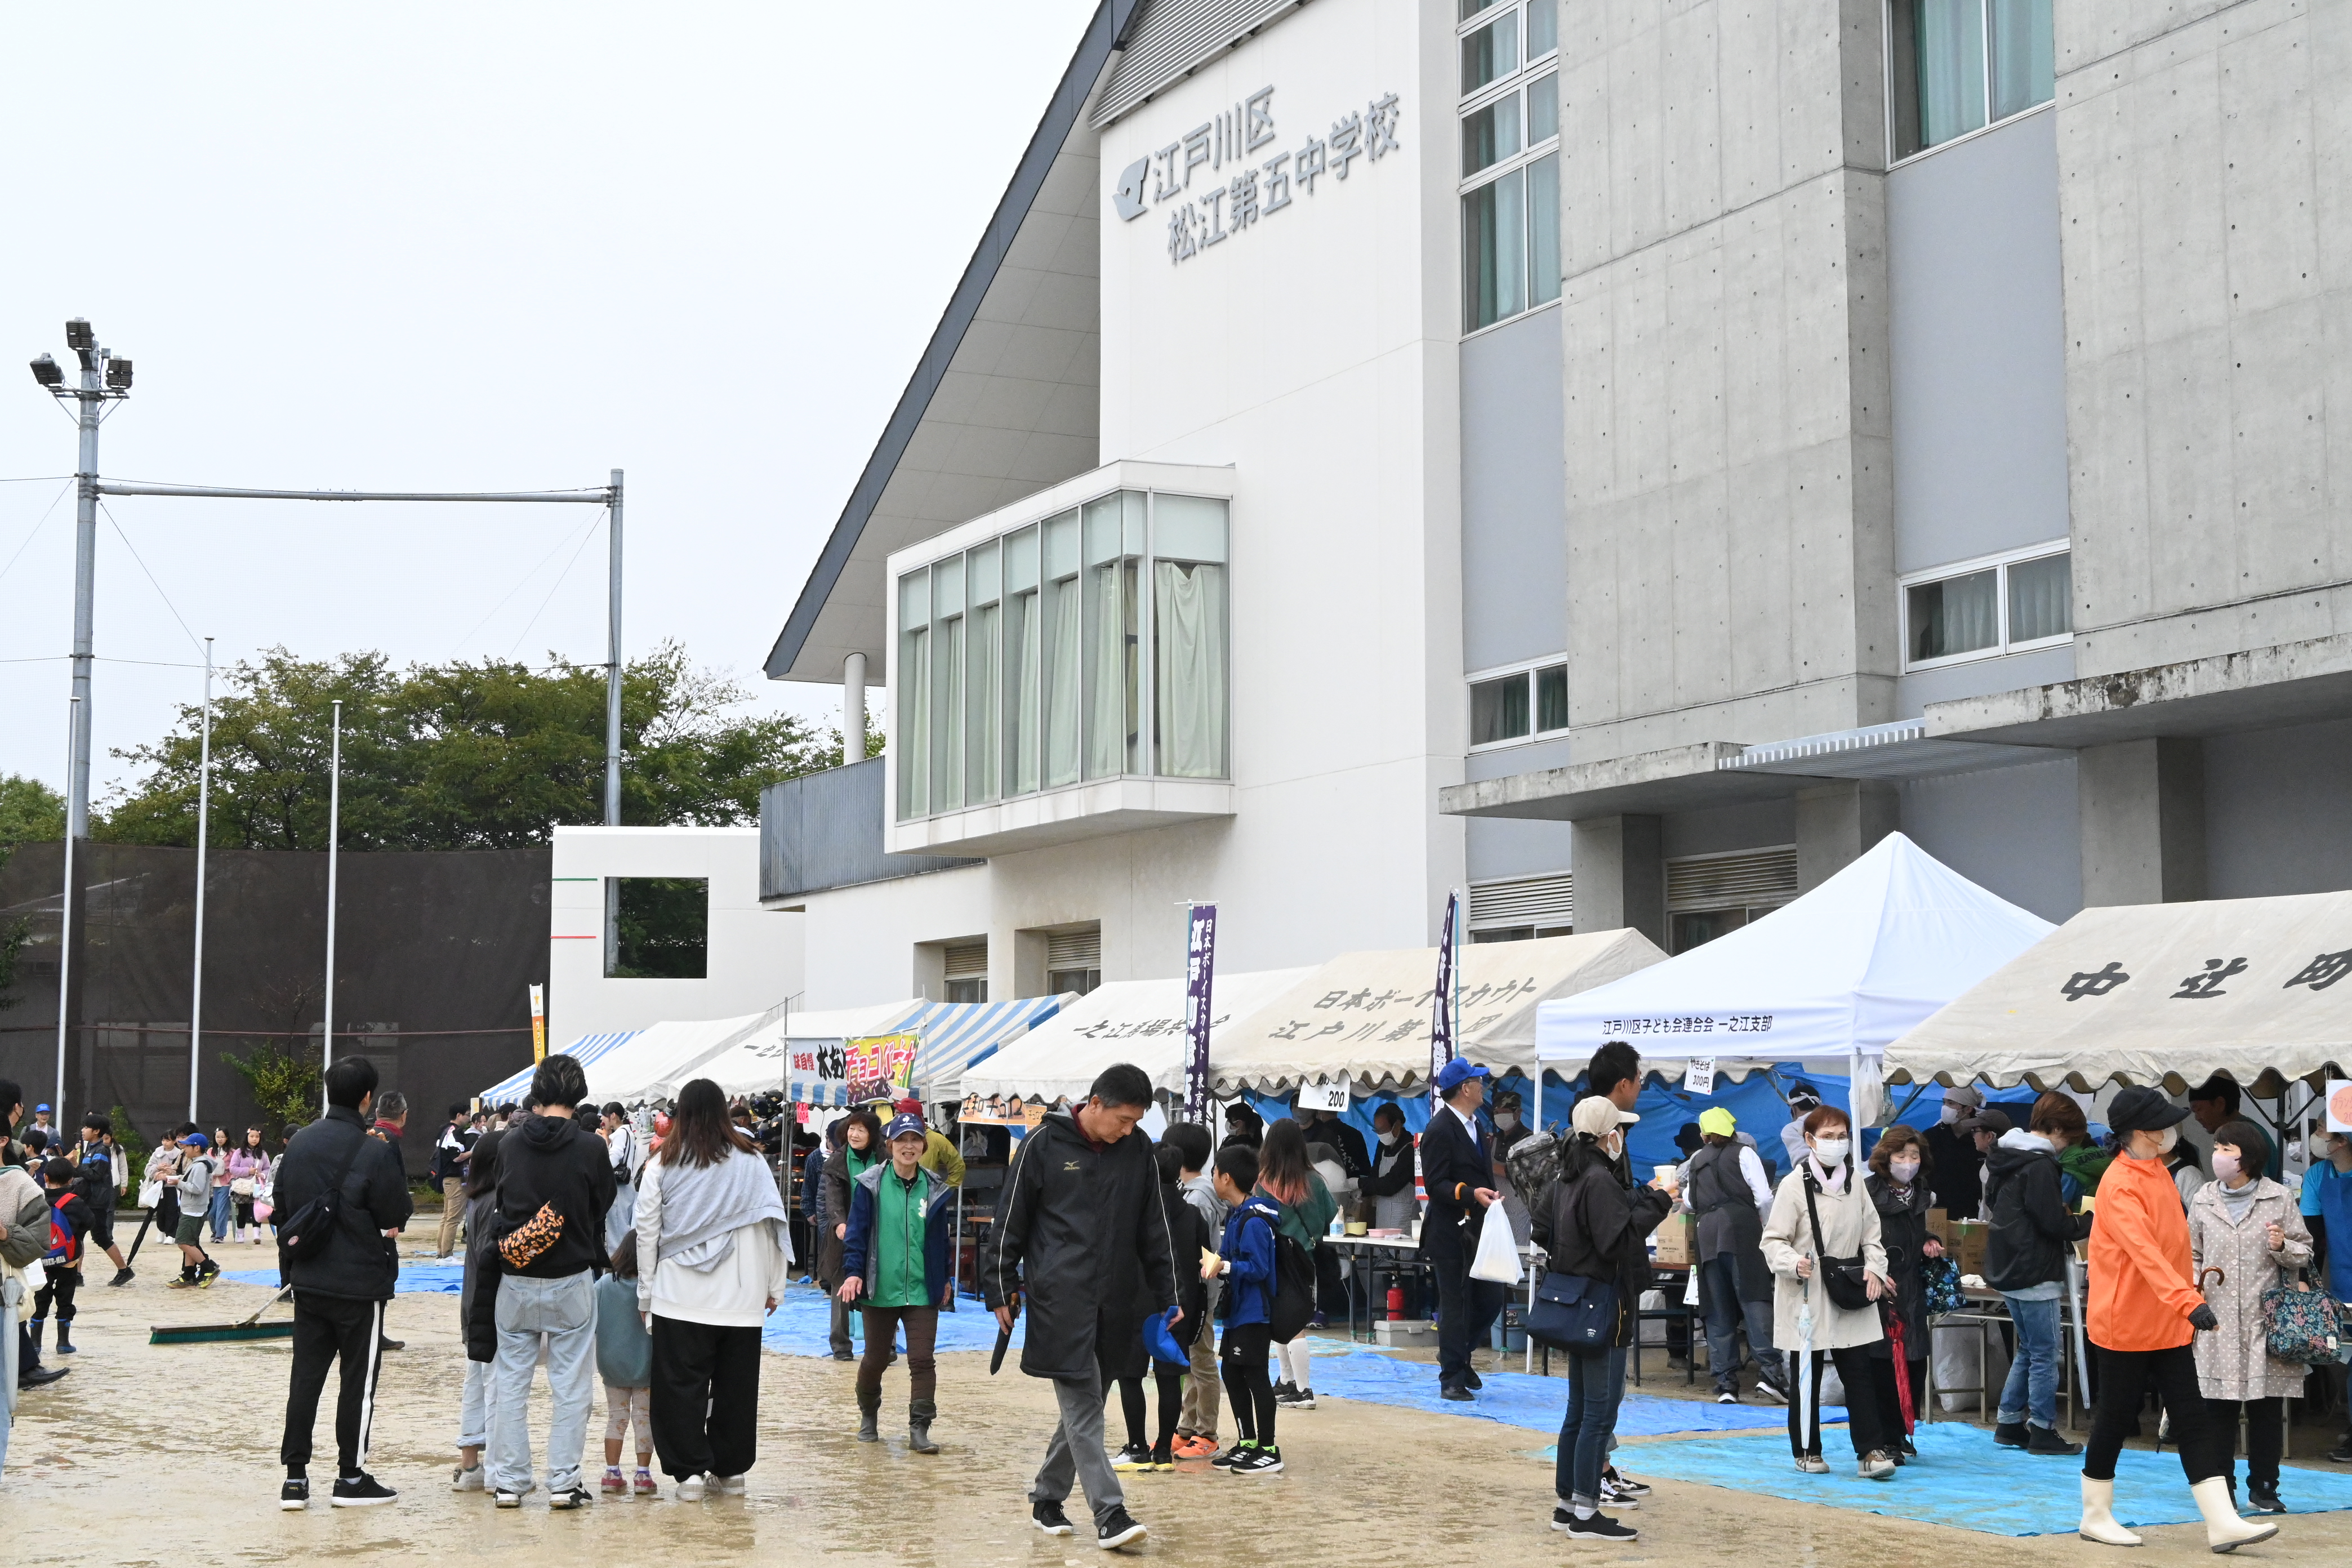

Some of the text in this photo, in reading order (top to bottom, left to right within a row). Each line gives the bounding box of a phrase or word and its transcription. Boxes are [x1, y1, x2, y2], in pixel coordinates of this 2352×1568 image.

[1152, 83, 1275, 204] 江戸川区
[1167, 91, 1400, 266] 松江第五中学校
[1199, 919, 1214, 1060] 日本ボーイスカウト
[1602, 1014, 1772, 1035] 江戸川区子ども会連合会 一之江支部
[792, 1052, 815, 1071] 味自慢
[1690, 1058, 1710, 1072] やきそば
[1692, 1074, 1709, 1088] 300円
[2332, 1096, 2352, 1110] フラン
